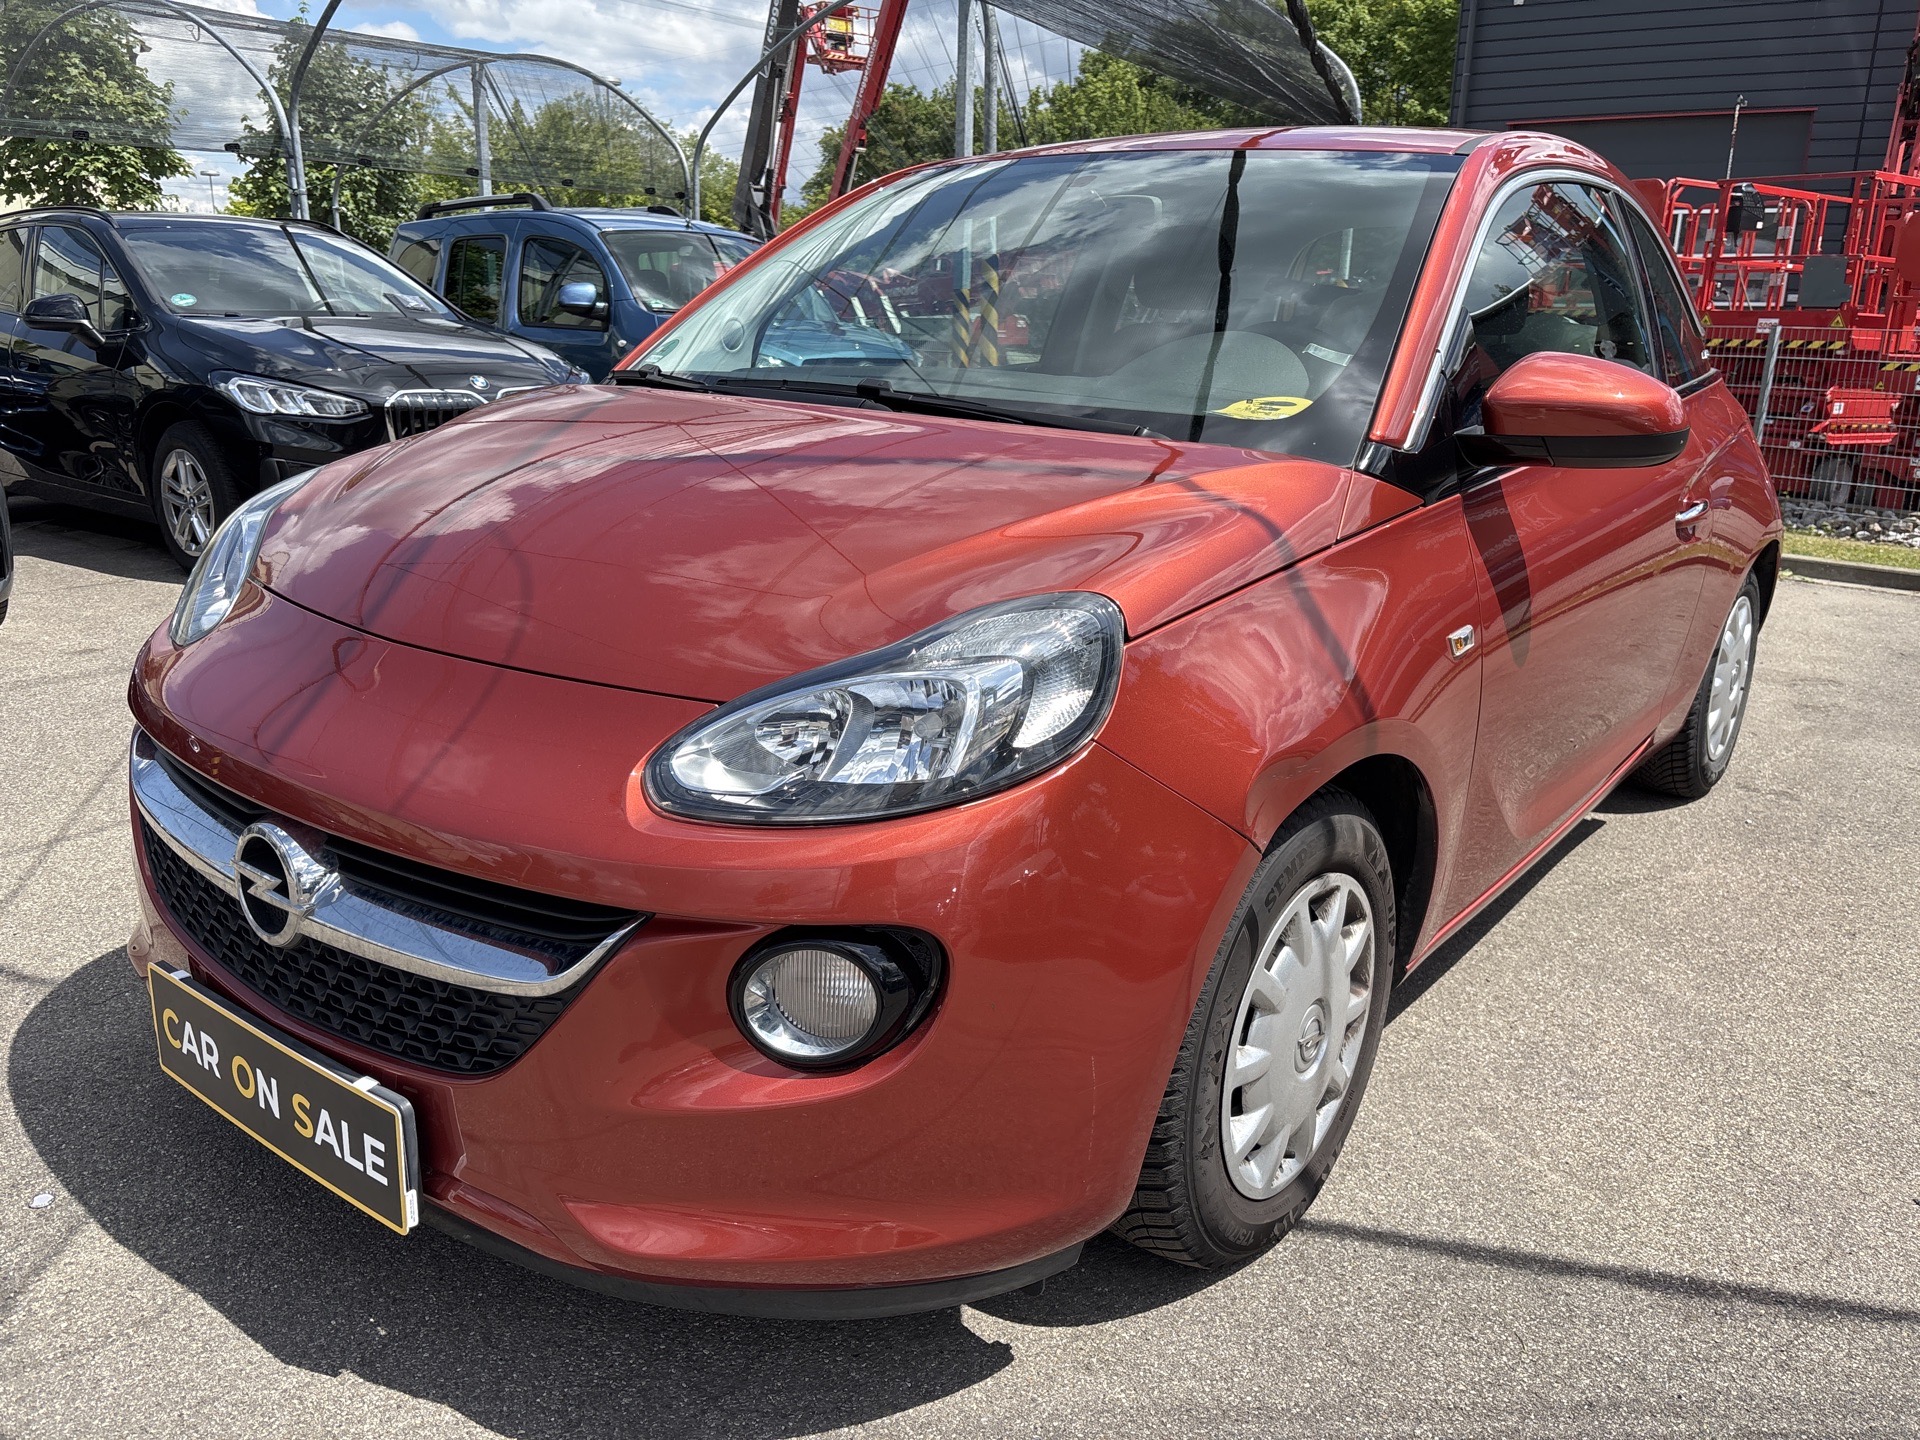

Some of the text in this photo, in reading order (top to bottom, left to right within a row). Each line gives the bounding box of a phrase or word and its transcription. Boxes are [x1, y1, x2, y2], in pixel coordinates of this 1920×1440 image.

[162, 1008, 388, 1187] CAR ON SALE
